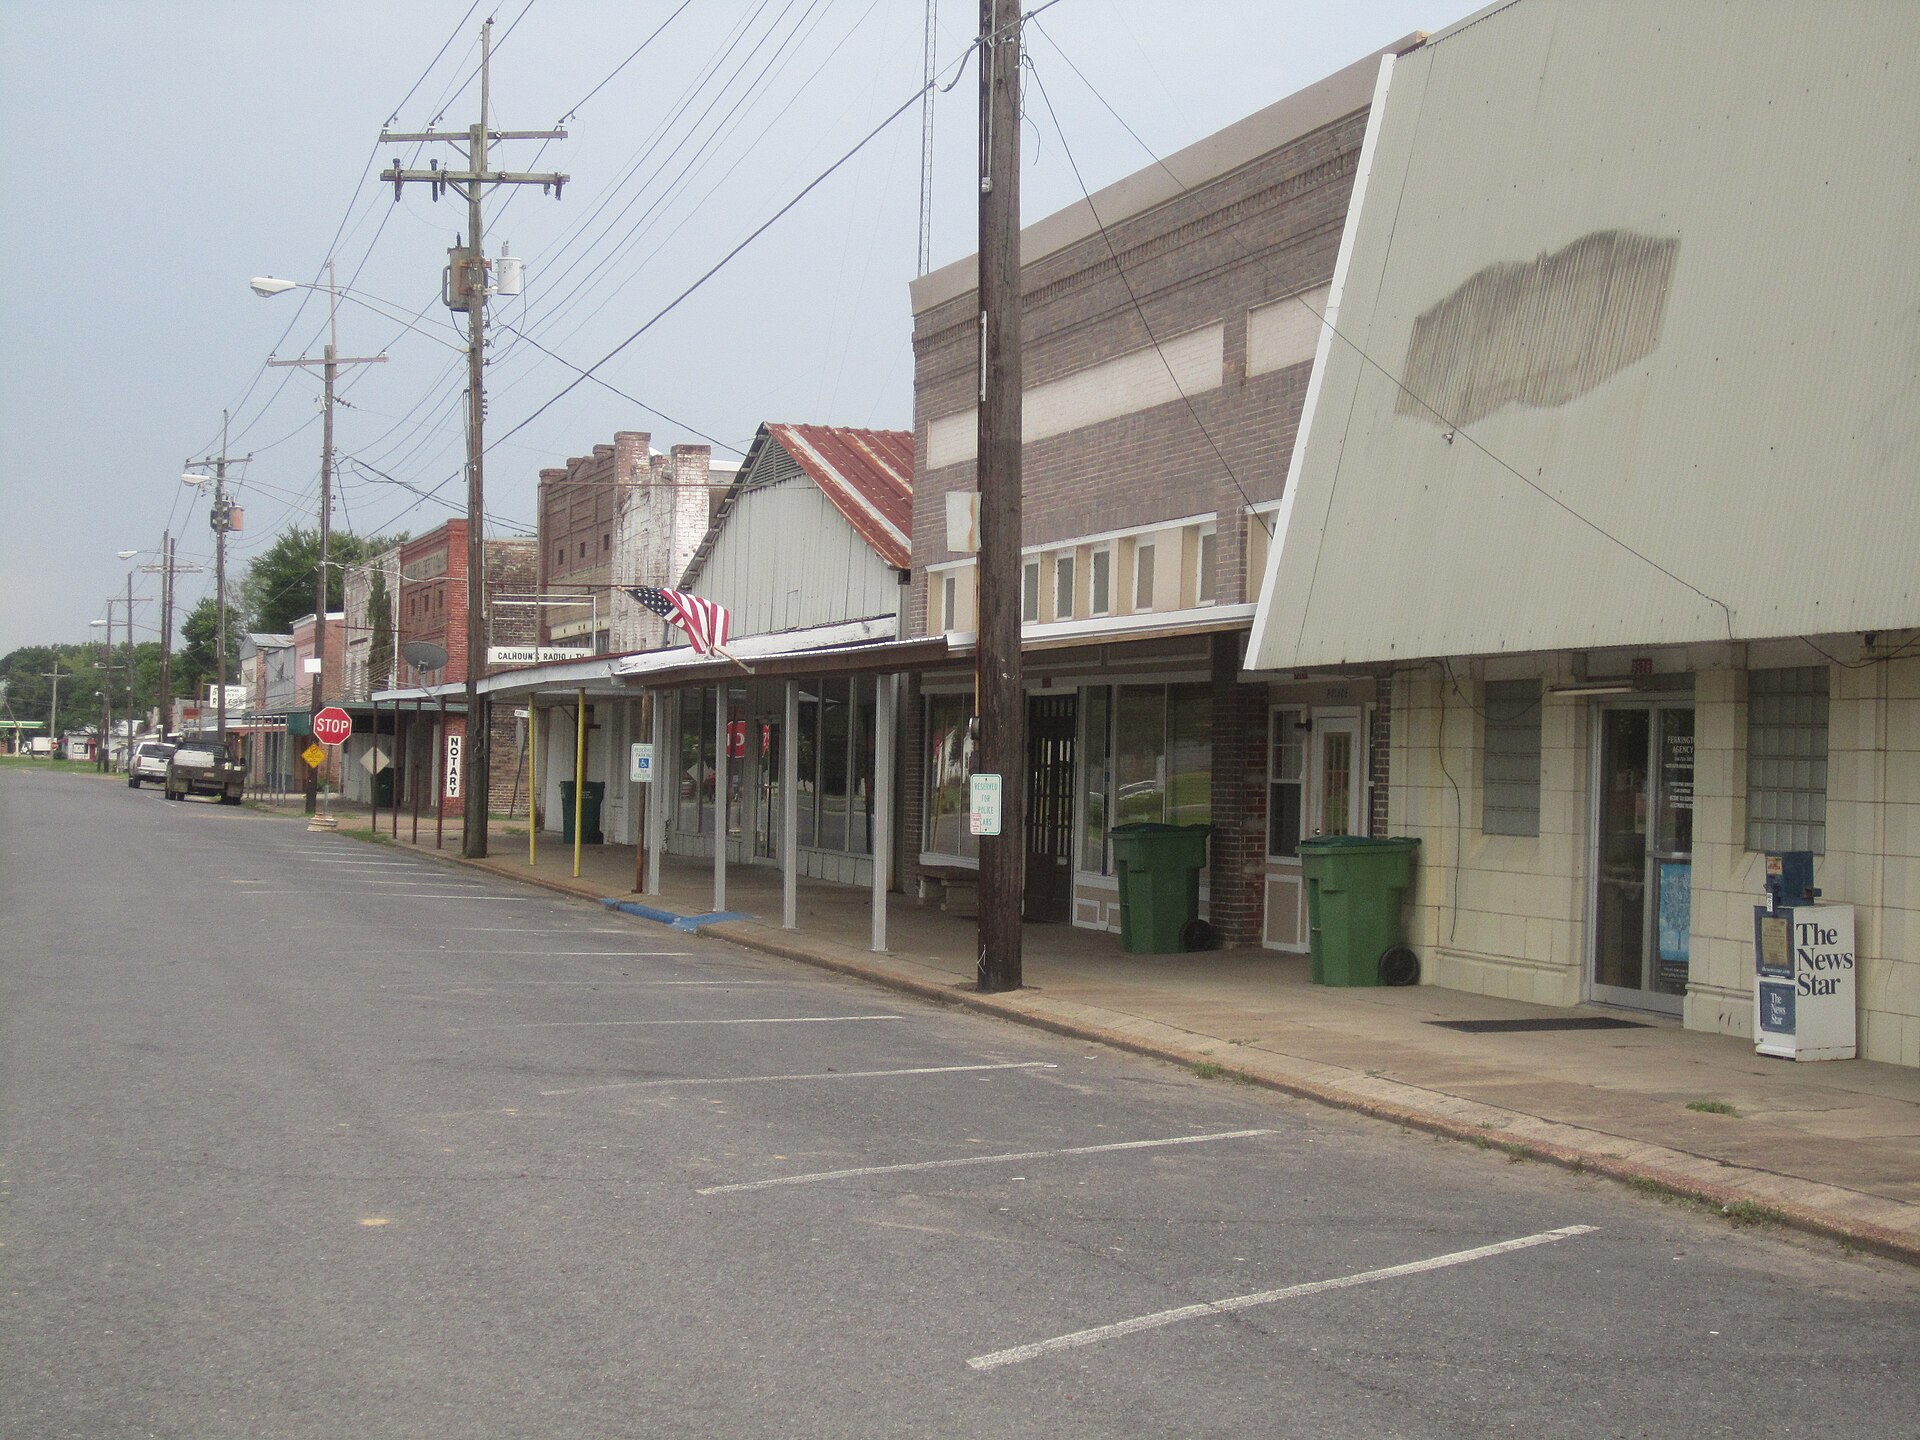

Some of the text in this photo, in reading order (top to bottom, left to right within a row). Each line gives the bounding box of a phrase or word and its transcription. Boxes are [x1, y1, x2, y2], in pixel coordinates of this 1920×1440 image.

[543, 652, 567, 661] RADIO
[316, 718, 349, 733] STOP
[449, 737, 459, 795] NOTARY
[974, 782, 998, 790] RESERVED
[981, 794, 991, 802] FOR
[977, 806, 994, 814] POLICE
[981, 818, 992, 826] ARS
[1795, 923, 1838, 946] The
[1796, 947, 1853, 971] News
[1797, 972, 1841, 997] Star
[1770, 992, 1782, 1004] The
[1770, 1003, 1786, 1016] News
[1770, 1014, 1783, 1025] Star
